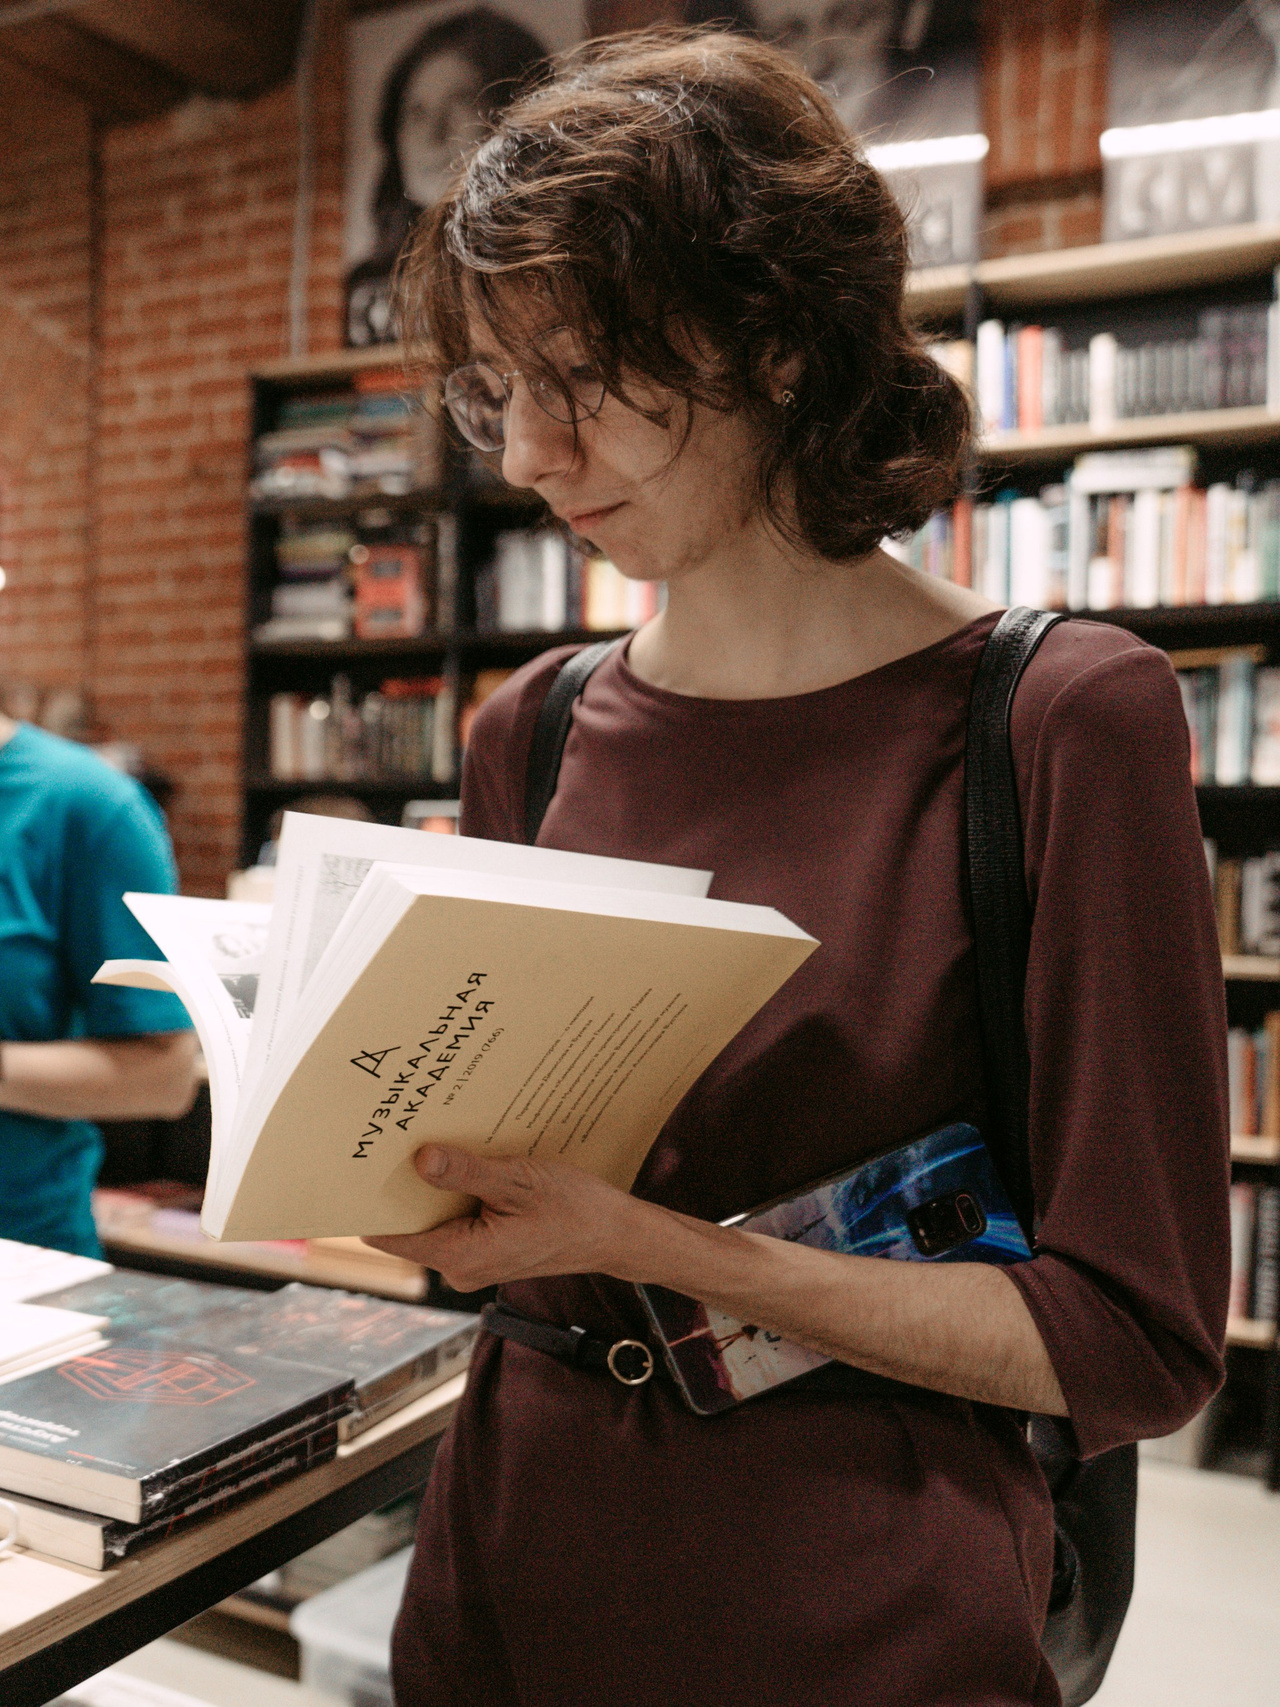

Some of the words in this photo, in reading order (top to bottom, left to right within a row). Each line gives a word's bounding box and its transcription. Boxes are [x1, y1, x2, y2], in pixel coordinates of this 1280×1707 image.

[352, 972, 487, 1158] МУЗЫКАЛЬНАЯ
[396, 1000, 495, 1131] АКАДЕМИЯ
[443, 1093, 455, 1106] №
[453, 1083, 463, 1091] 2
[463, 1053, 483, 1077] 2019
[481, 1027, 505, 1052] (766)
